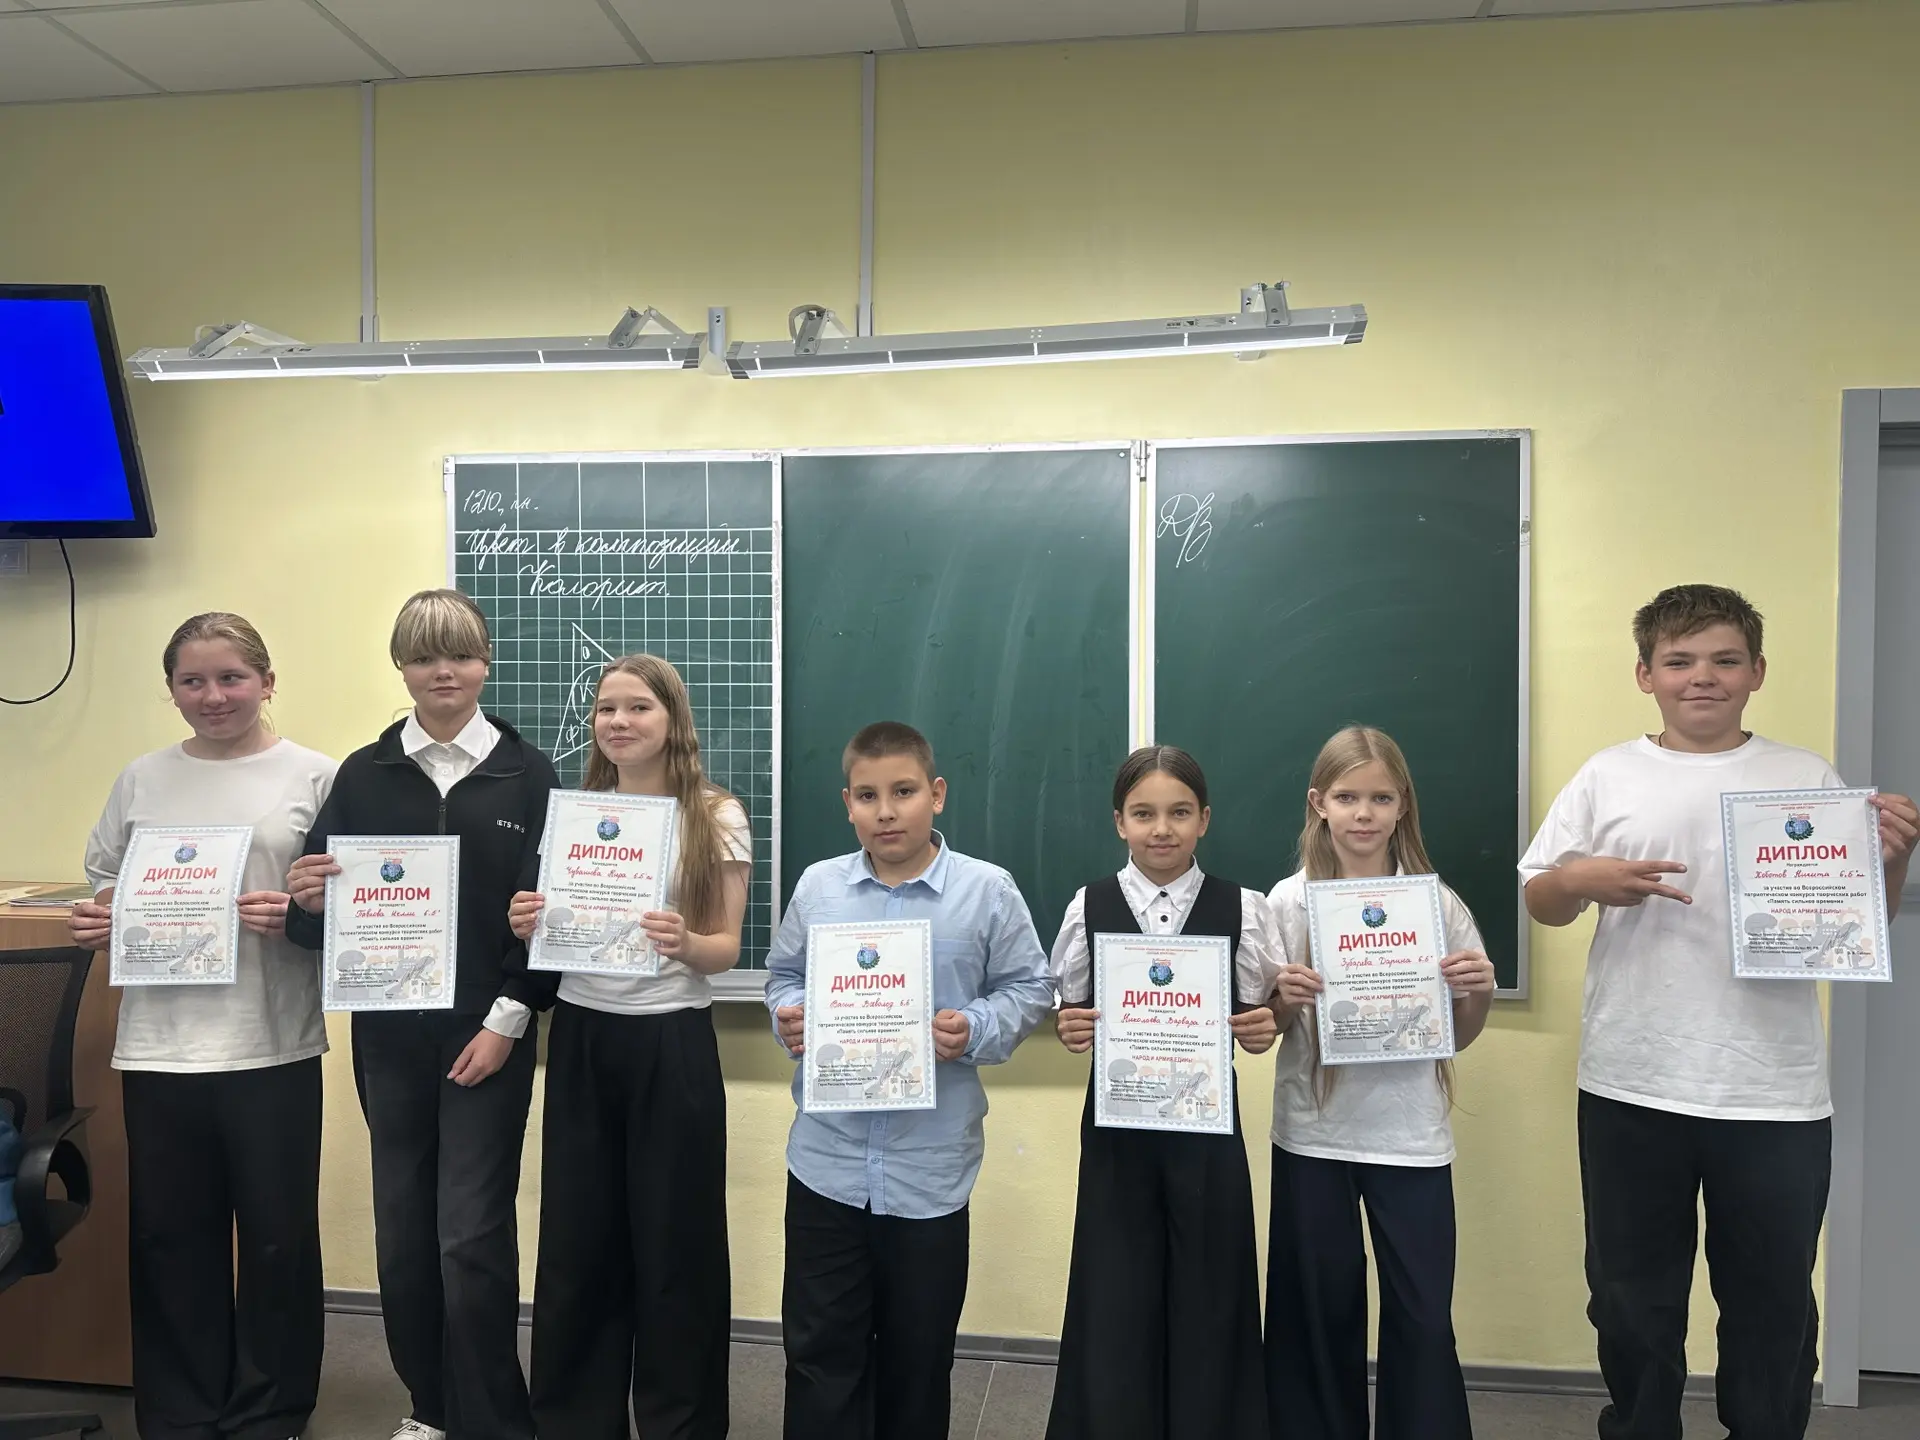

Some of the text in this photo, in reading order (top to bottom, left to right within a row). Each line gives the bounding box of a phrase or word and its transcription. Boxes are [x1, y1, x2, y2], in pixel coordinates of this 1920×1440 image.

[548, 527, 569, 555] в
[568, 844, 643, 862] ДИПЛОМ
[1756, 845, 1847, 863] ДИПЛОМ
[143, 867, 217, 882] ДИПЛОМ
[1794, 870, 1830, 878] Никита
[353, 887, 430, 904] ДИПЛОМ
[1339, 931, 1416, 952] ДИПЛОМ
[831, 974, 905, 993] ДИПЛОМ
[1123, 990, 1201, 1008] ДИПЛОМ
[1166, 1017, 1199, 1028] Варвара
